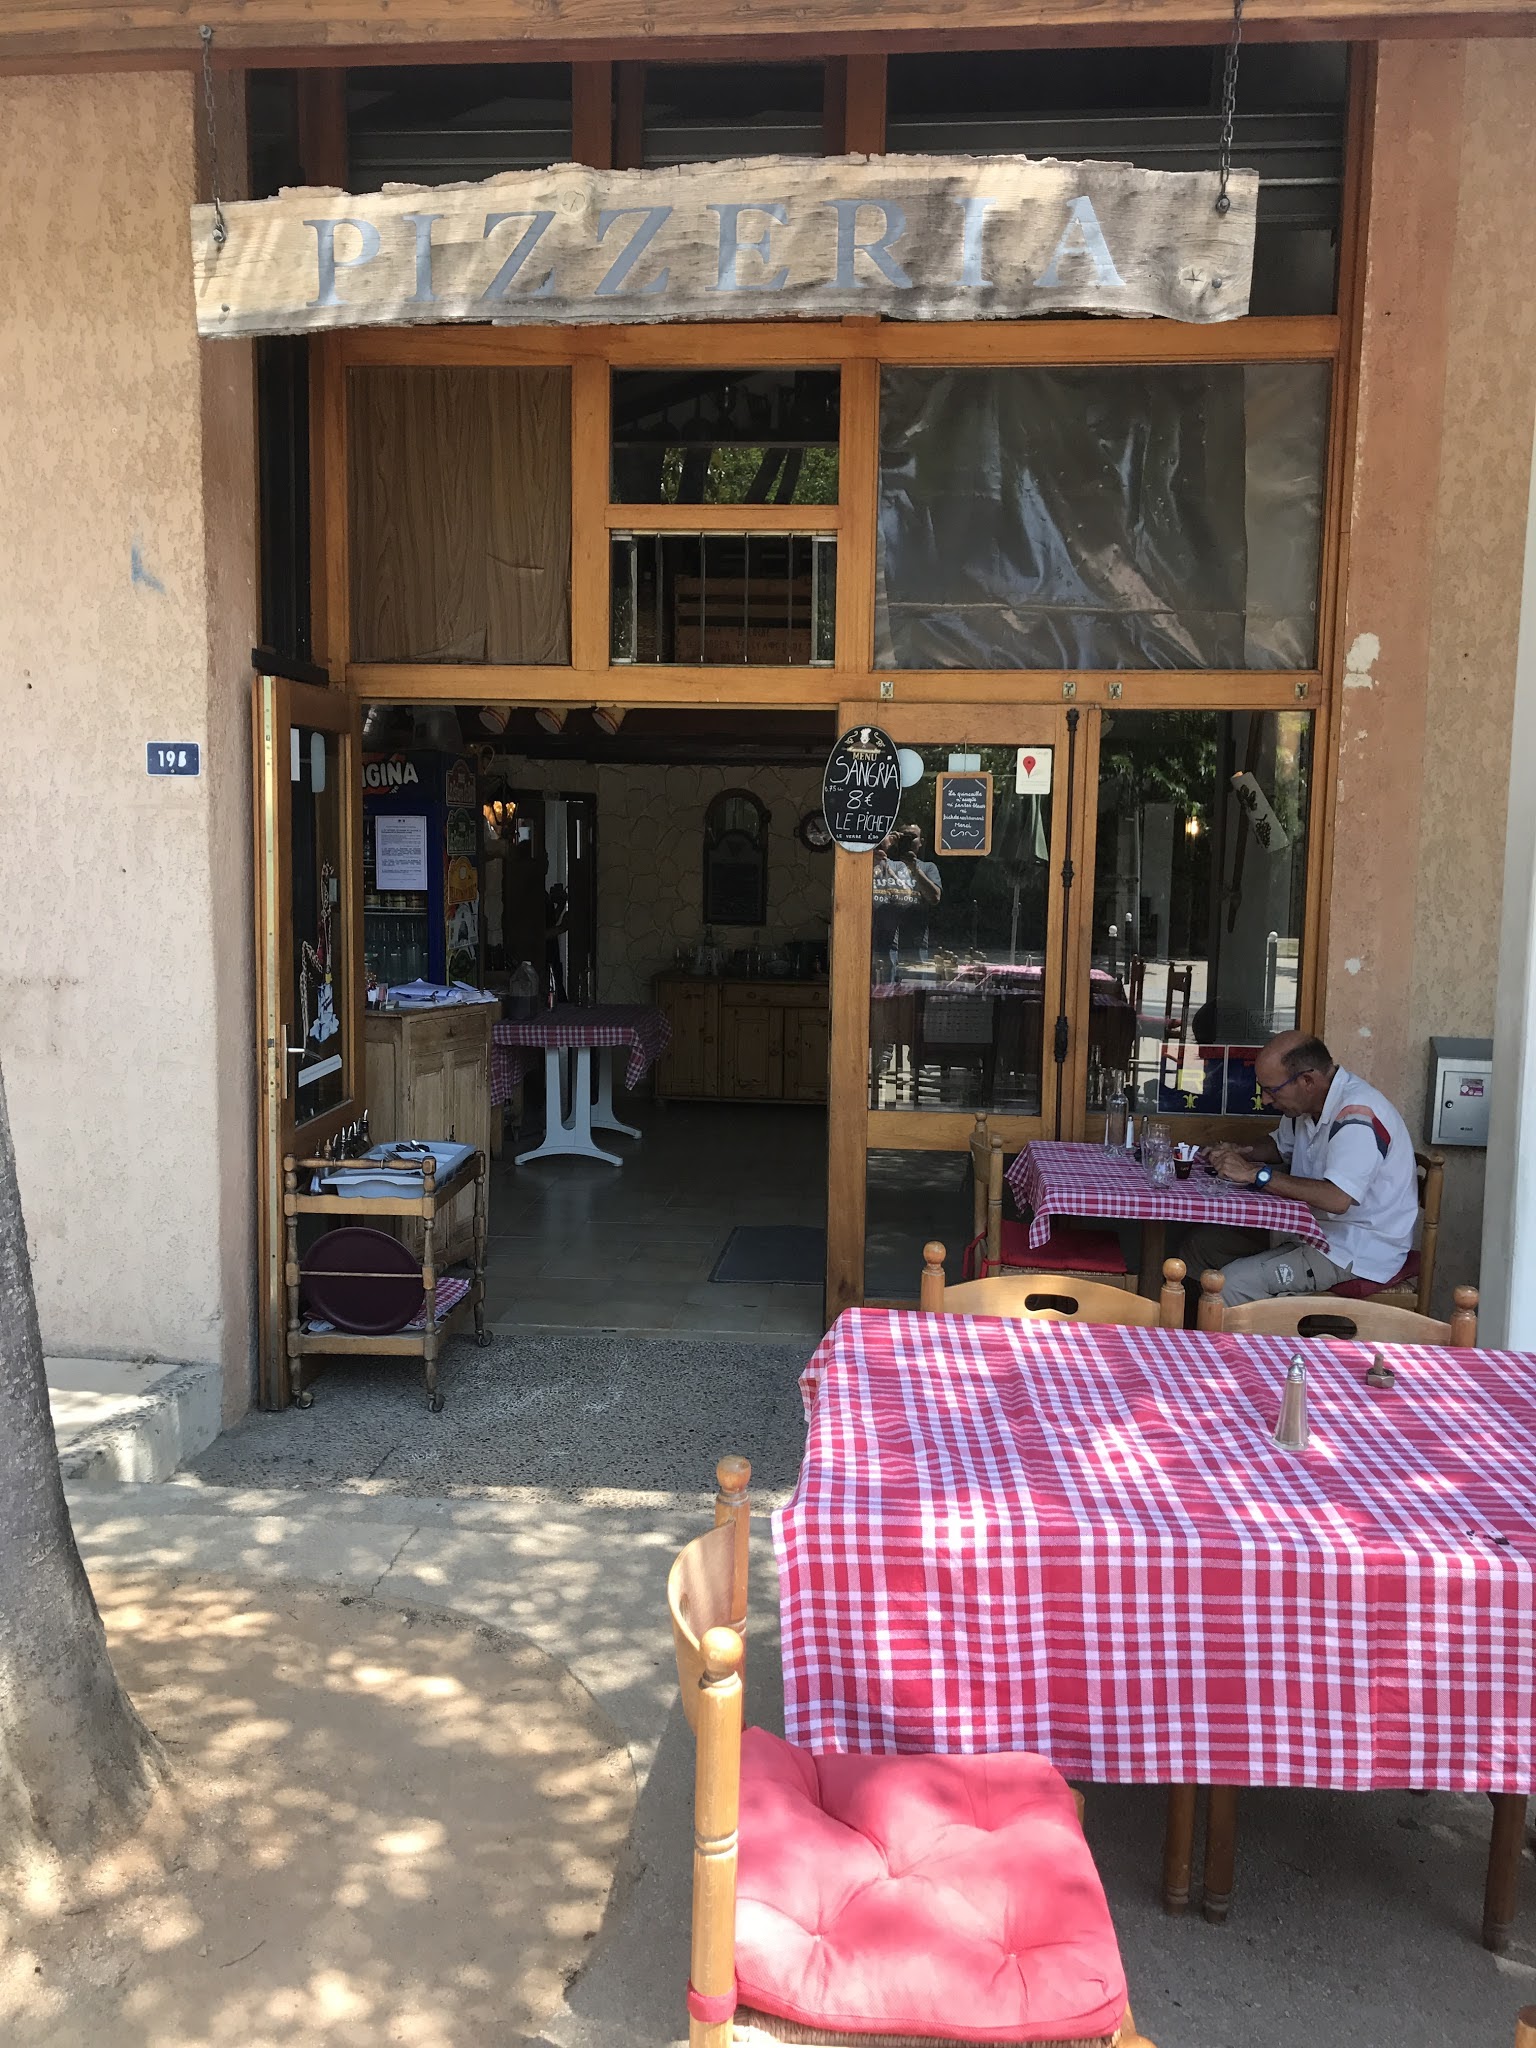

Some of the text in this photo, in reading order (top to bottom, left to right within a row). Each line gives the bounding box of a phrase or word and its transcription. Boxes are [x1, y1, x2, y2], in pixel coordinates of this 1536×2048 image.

[302, 195, 1127, 308] PIZZERIA
[853, 752, 878, 761] MENU
[836, 812, 854, 831] LE
